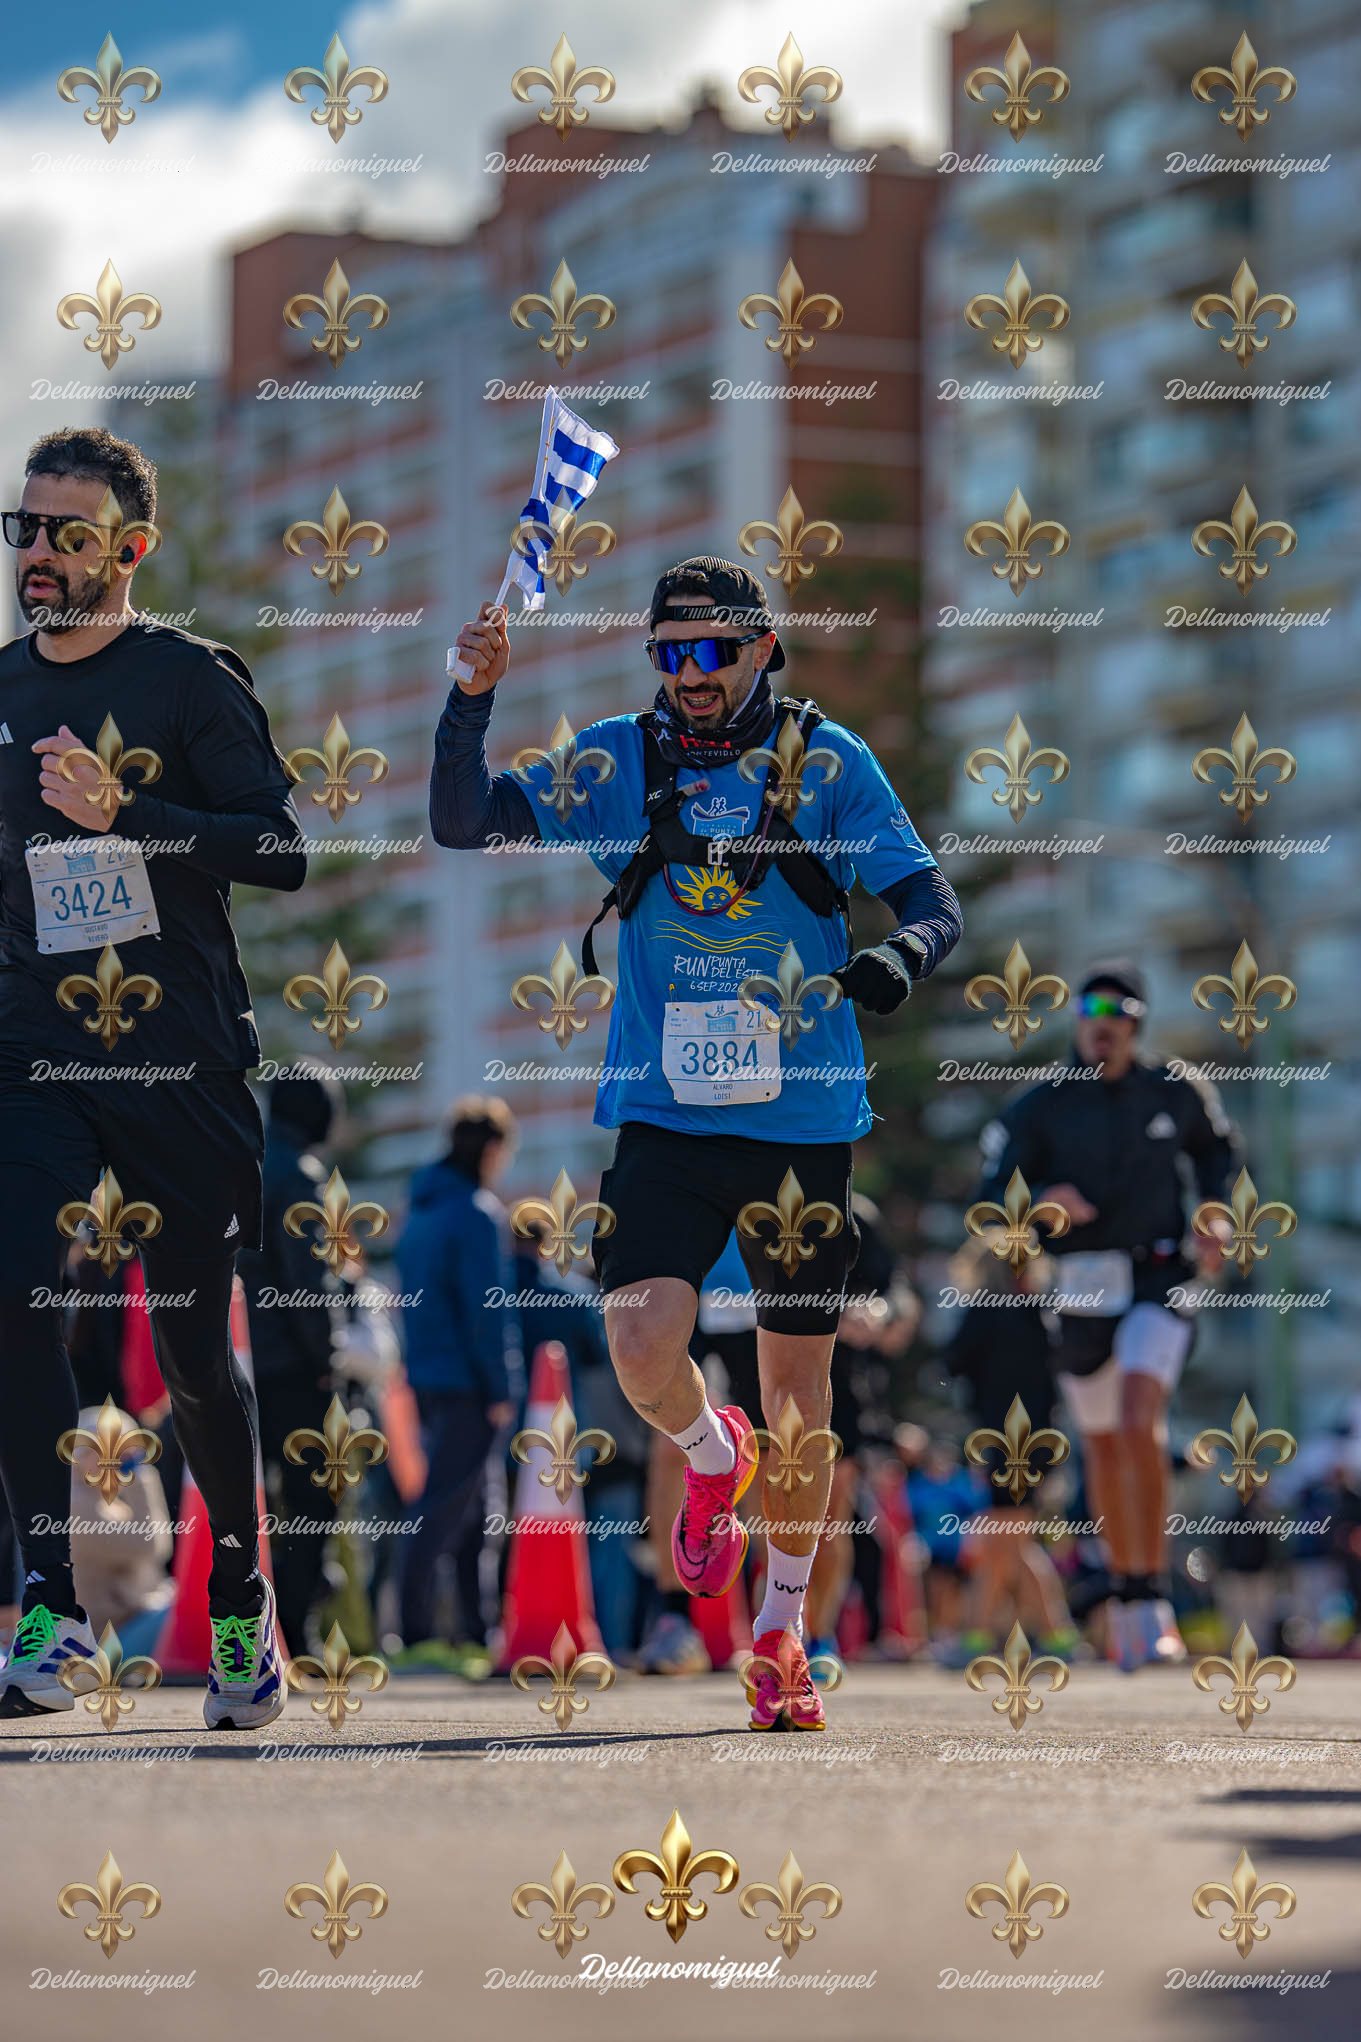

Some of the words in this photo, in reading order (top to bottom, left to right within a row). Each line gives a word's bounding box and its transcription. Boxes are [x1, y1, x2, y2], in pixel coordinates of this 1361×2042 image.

[50, 874, 133, 922] 3424
[673, 954, 711, 978] RUN
[710, 955, 746, 970] PUNTA
[710, 967, 731, 980] DEL
[735, 968, 762, 981] ESTE
[690, 980, 696, 990] 6
[696, 981, 717, 992] SEP
[717, 981, 745, 993] 2026
[680, 1039, 760, 1076] 3884
